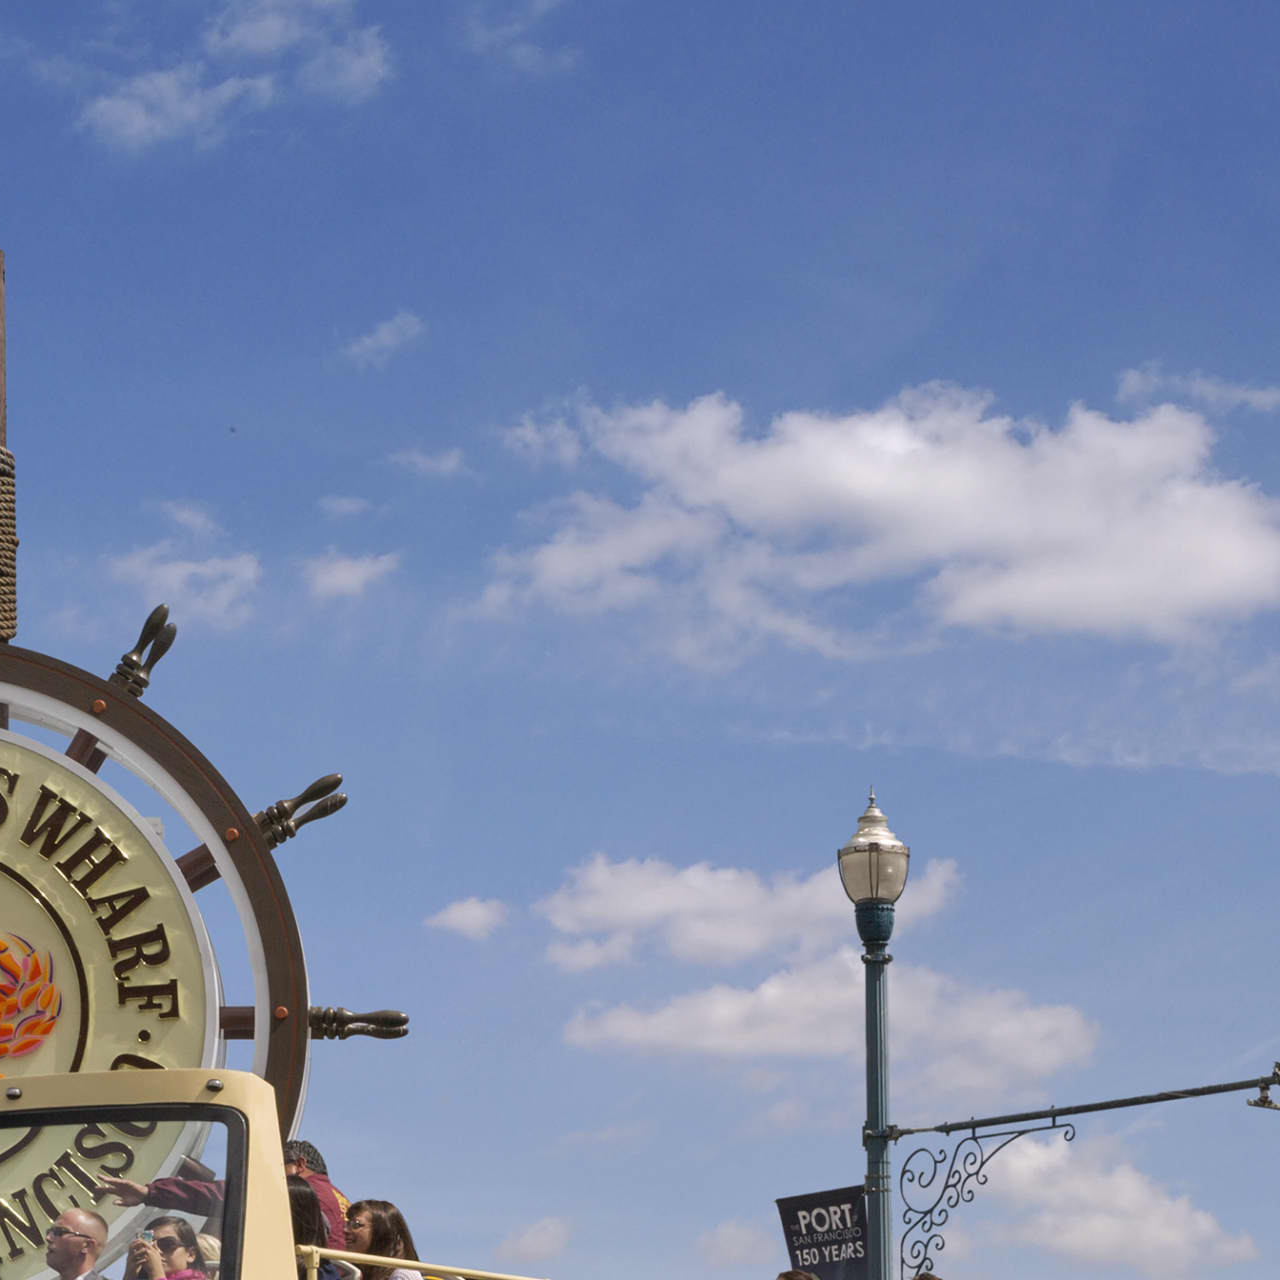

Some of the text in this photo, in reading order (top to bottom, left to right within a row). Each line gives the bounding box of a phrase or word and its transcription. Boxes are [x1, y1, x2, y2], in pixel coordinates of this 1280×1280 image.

[18, 782, 181, 1022] WHARF
[797, 1203, 853, 1235] PORT
[792, 1235, 812, 1247] SAN
[812, 1226, 863, 1244] FRANCISCO
[795, 1241, 865, 1267] 150 YEARS
